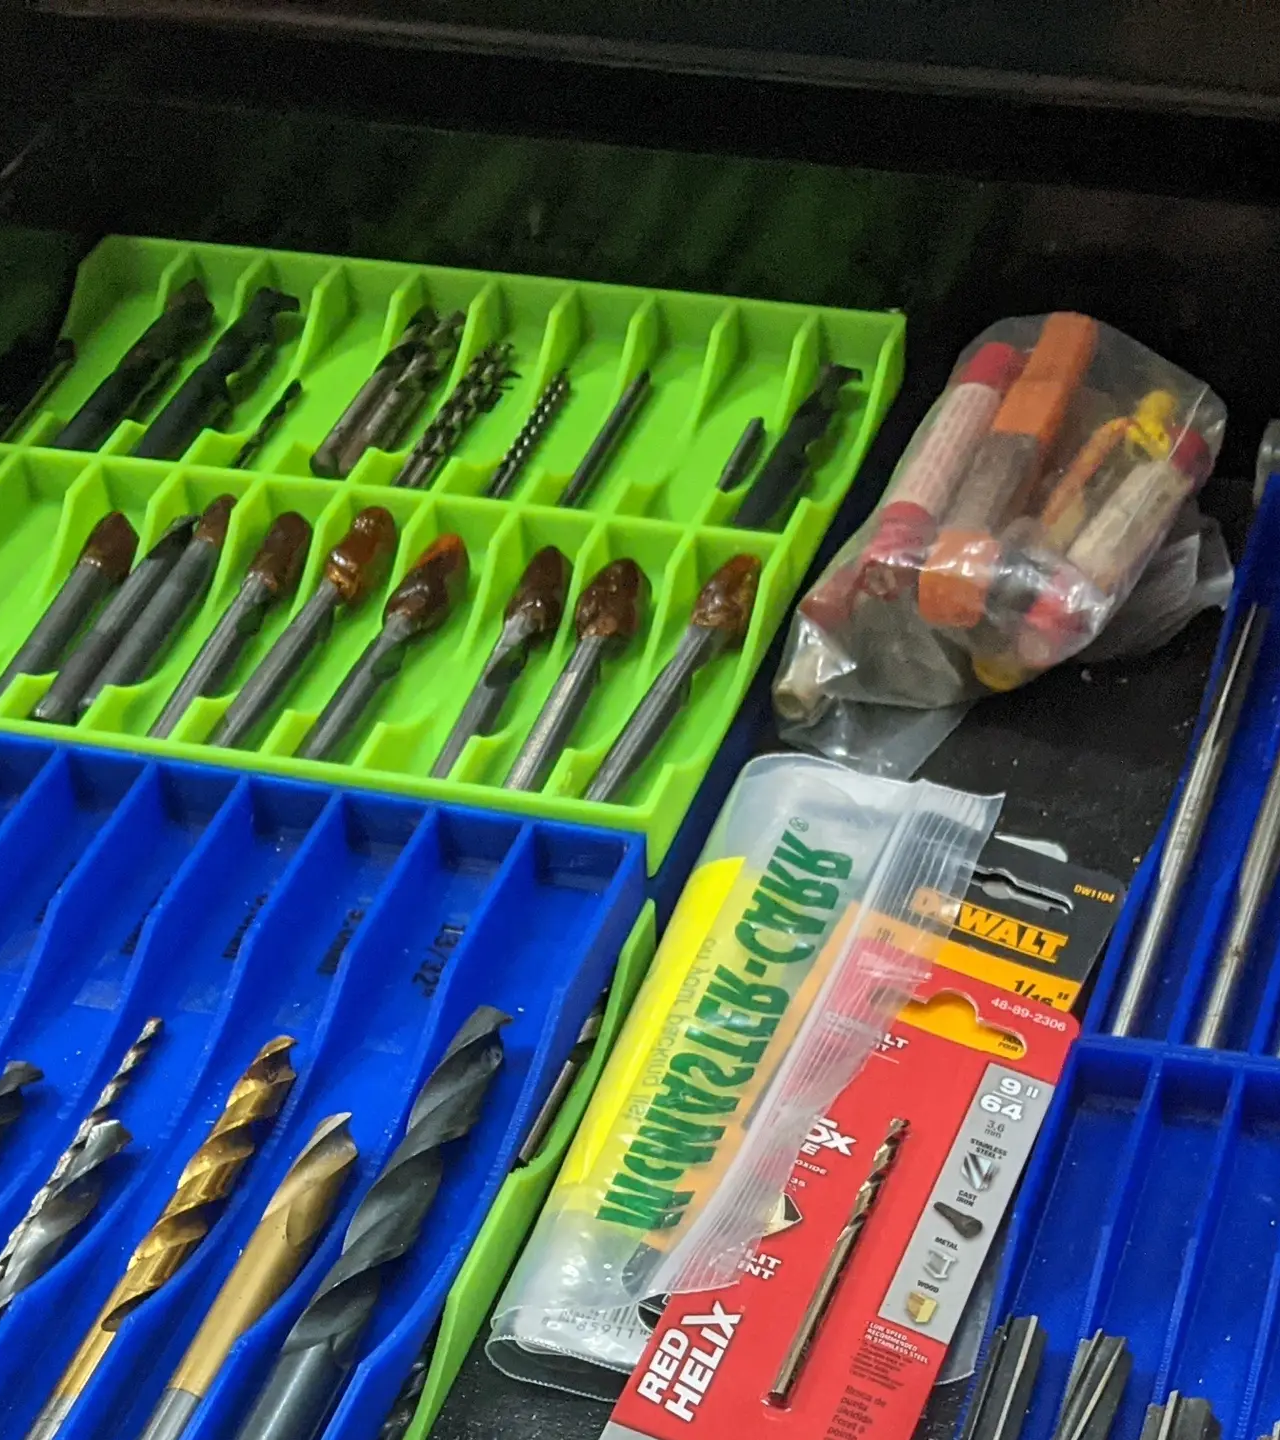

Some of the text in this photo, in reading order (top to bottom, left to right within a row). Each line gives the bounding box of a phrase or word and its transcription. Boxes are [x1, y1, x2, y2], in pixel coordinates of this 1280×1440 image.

[1073, 883, 1115, 903] DW1104
[991, 997, 1067, 1032] 48-89-2306
[980, 1094, 1024, 1121] 64
[970, 1138, 1008, 1157] STAINLESS
[956, 1196, 974, 1208] IRON
[958, 1189, 977, 1201] CAST
[935, 1236, 958, 1251] METAL
[917, 1280, 940, 1294] WOOD
[867, 1328, 918, 1351] RECOMMENDED
[886, 1328, 907, 1342] SPEED
[873, 1337, 909, 1358] STAINLESS
[910, 1350, 929, 1365] STEEL
[637, 1328, 689, 1404] RED
[665, 1301, 741, 1422] HELIX
